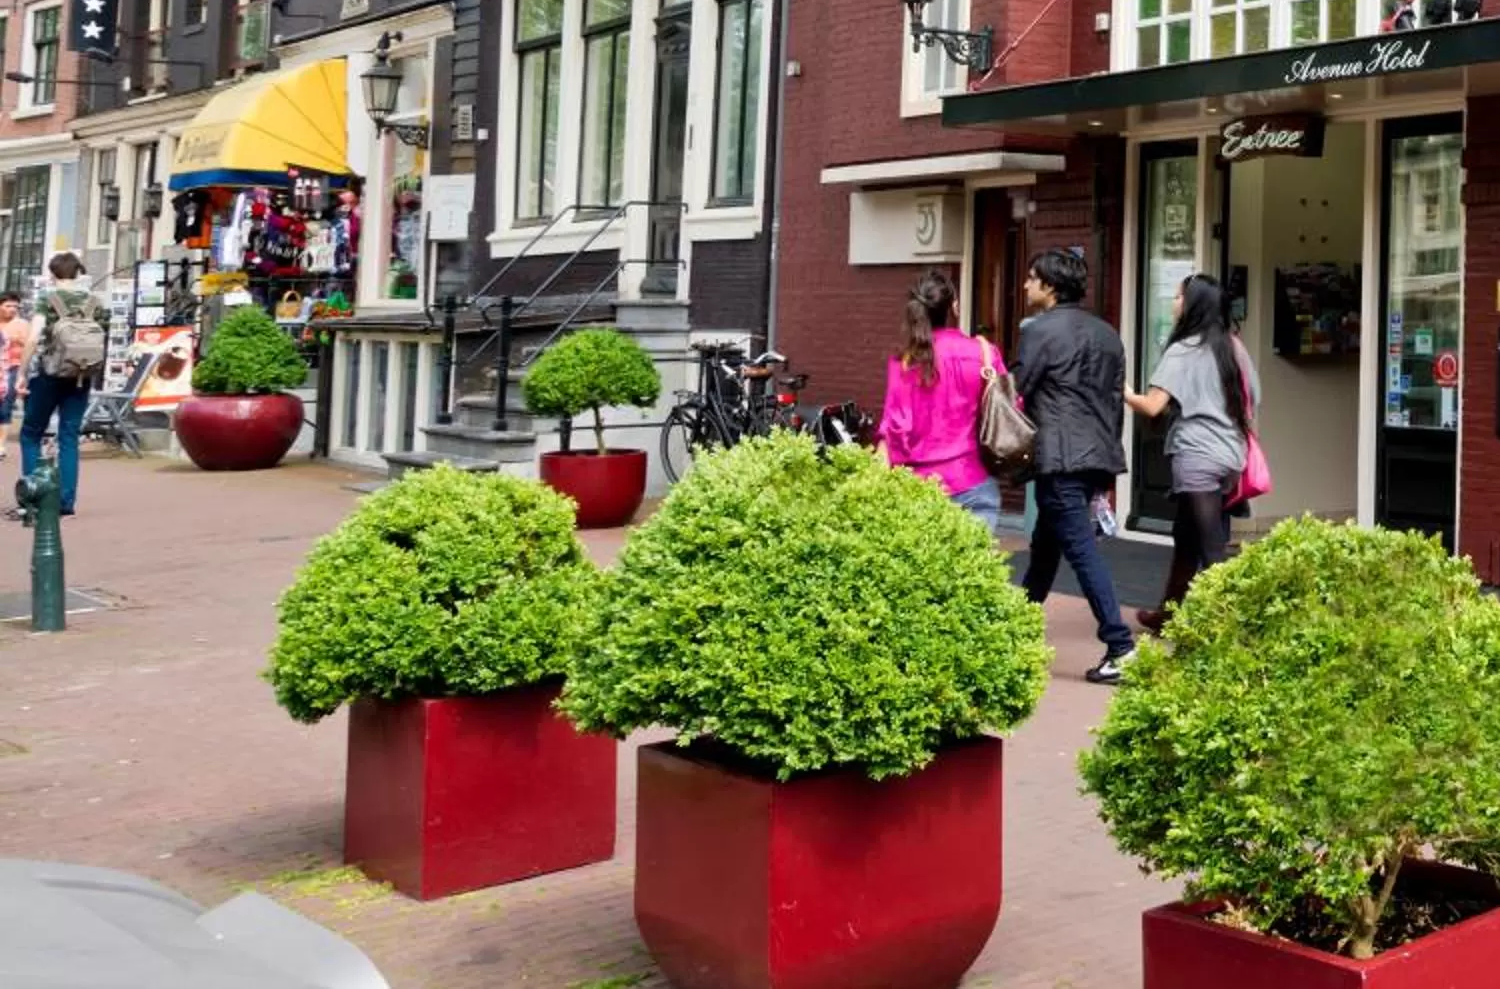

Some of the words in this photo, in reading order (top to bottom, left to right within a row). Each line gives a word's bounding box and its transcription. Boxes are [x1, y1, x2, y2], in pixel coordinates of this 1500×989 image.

[1284, 52, 1363, 84] Avenue
[1365, 40, 1431, 73] Hotel
[1221, 121, 1304, 159] Entree
